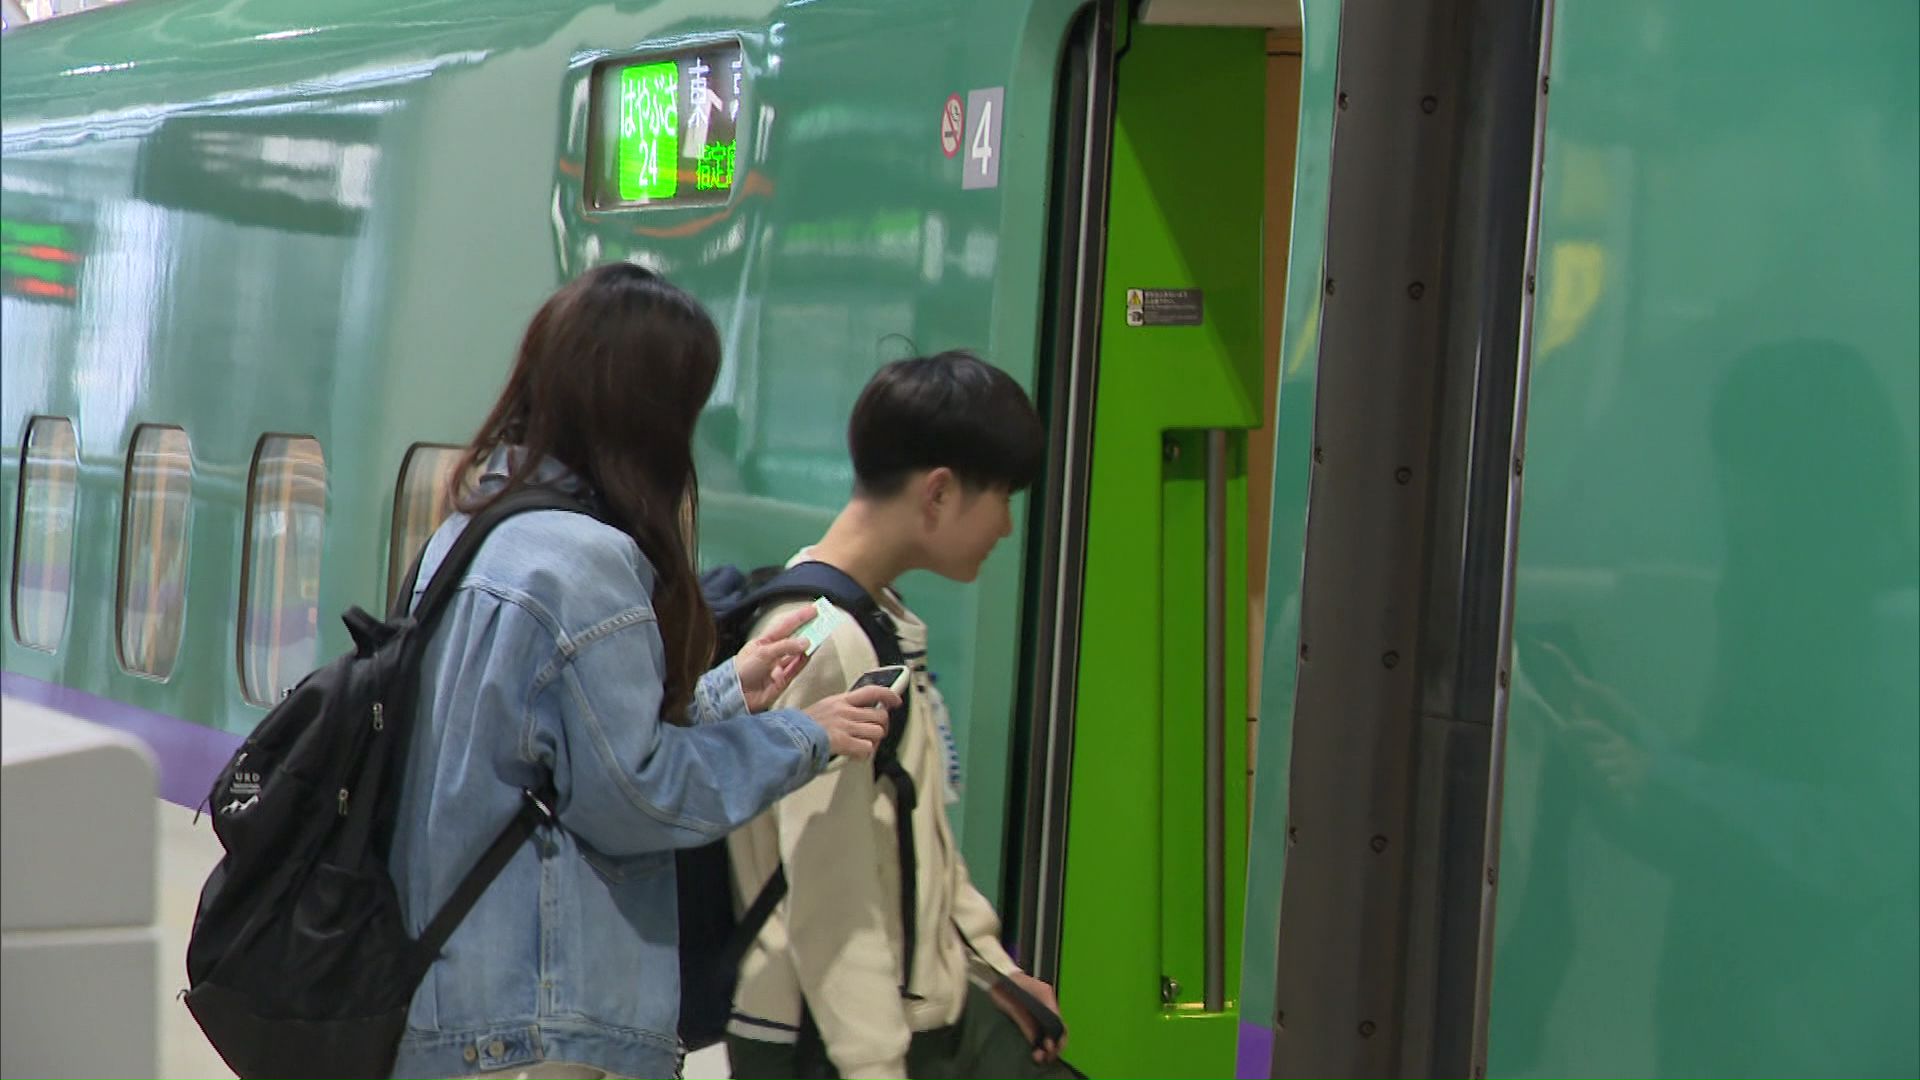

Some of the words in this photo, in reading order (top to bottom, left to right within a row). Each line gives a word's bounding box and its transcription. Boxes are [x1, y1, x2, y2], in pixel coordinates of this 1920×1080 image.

[621, 74, 678, 138] はやぶさ
[972, 100, 992, 175] 4
[639, 138, 658, 186] 24
